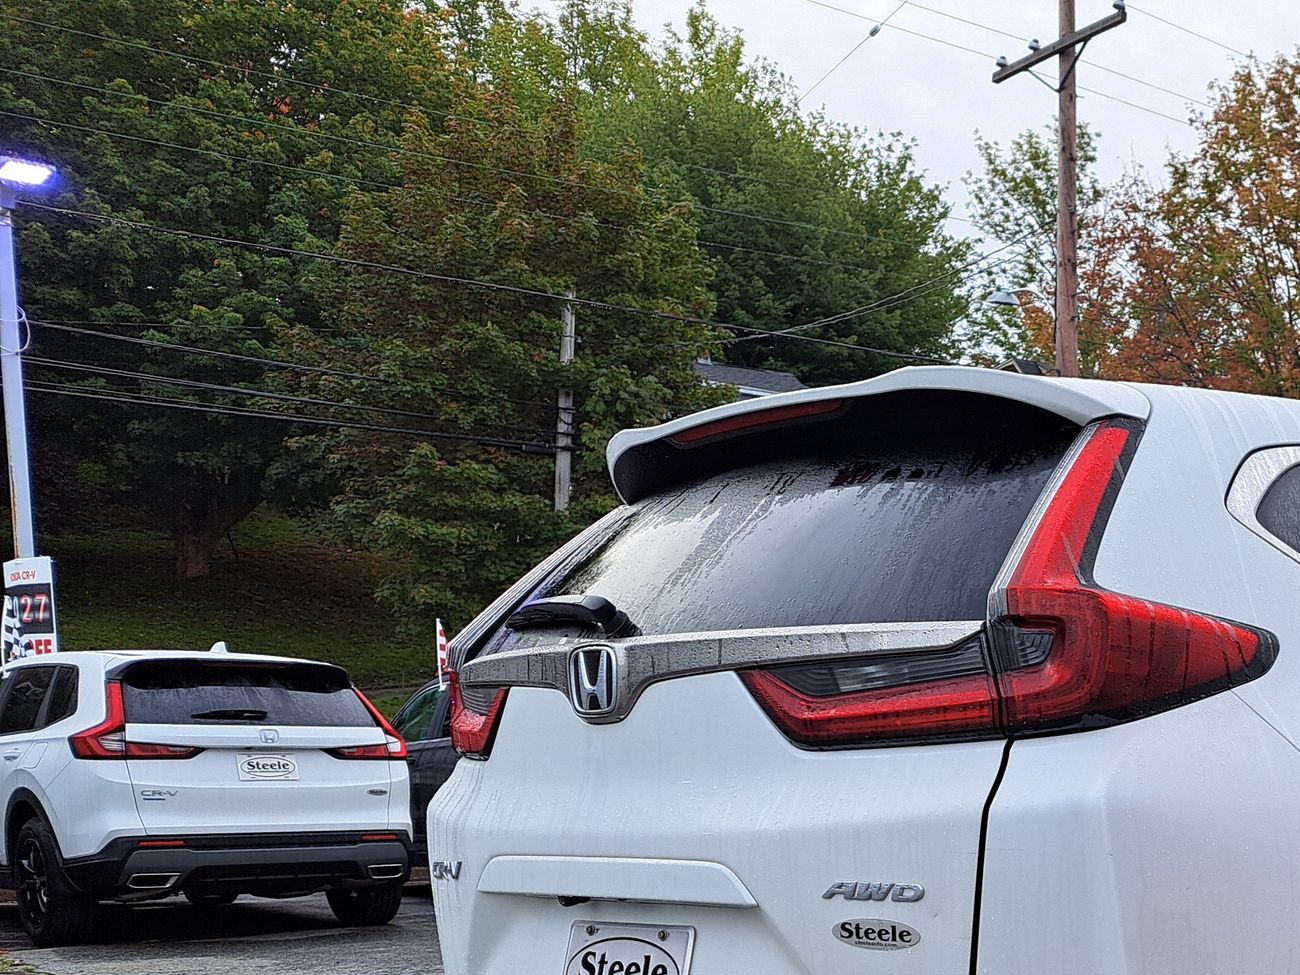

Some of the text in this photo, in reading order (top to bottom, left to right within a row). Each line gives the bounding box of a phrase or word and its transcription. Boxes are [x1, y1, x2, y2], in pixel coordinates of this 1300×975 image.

[247, 761, 290, 770] Steele
[140, 789, 179, 797] CR-V
[821, 880, 925, 903] AWD
[839, 921, 912, 944] Steele
